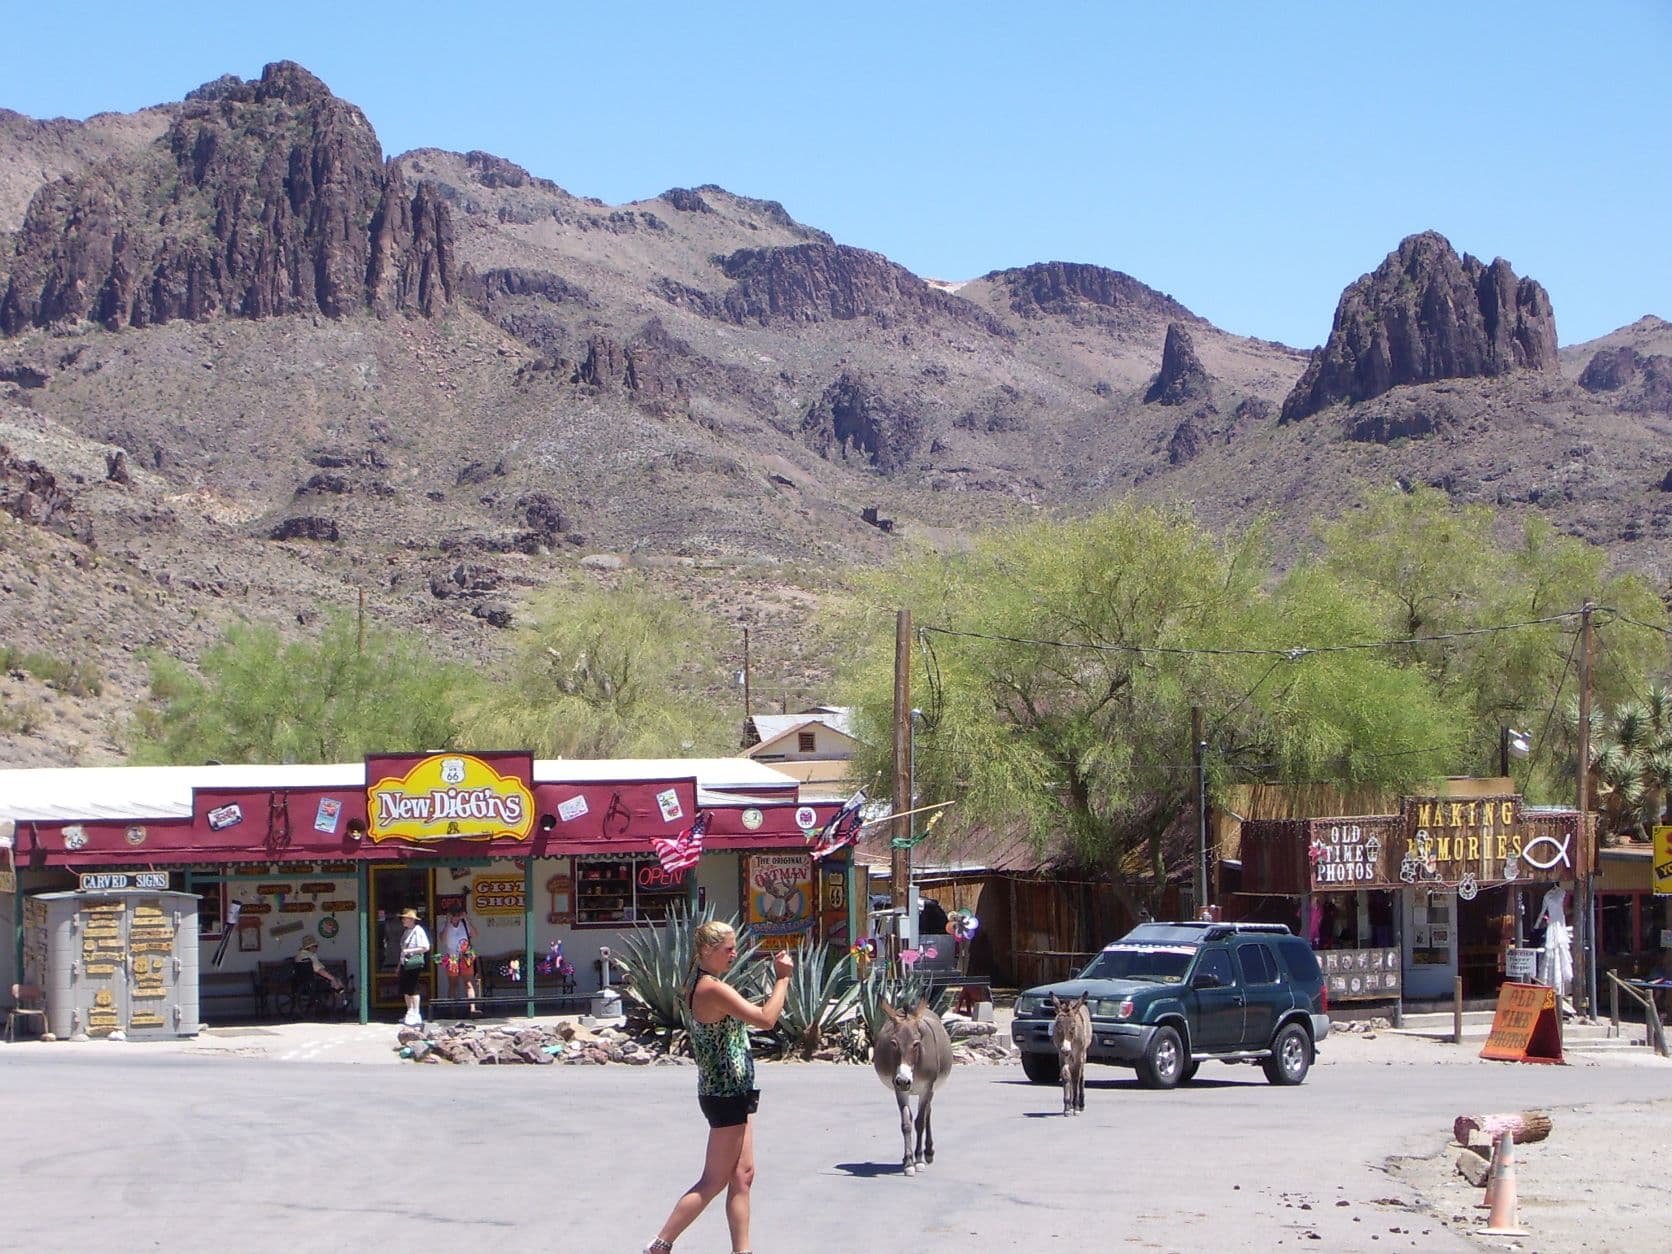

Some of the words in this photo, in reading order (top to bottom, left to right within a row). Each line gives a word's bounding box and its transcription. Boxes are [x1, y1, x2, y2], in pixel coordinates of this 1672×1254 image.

[447, 772, 459, 781] 66
[378, 792, 431, 826] New
[1417, 801, 1513, 828] MAKING
[70, 837, 84, 848] 66
[1330, 825, 1361, 843] OLD
[756, 856, 770, 867] THE
[1325, 844, 1364, 863] TIME
[82, 873, 128, 889] CARVED
[135, 873, 166, 888] SIGNS
[638, 867, 683, 886] OPEN
[1316, 862, 1374, 882] PHOTOS
[476, 881, 525, 894] GIFT
[830, 889, 841, 905] 66
[1510, 988, 1536, 1010] OLD
[1501, 1010, 1533, 1029] TIME
